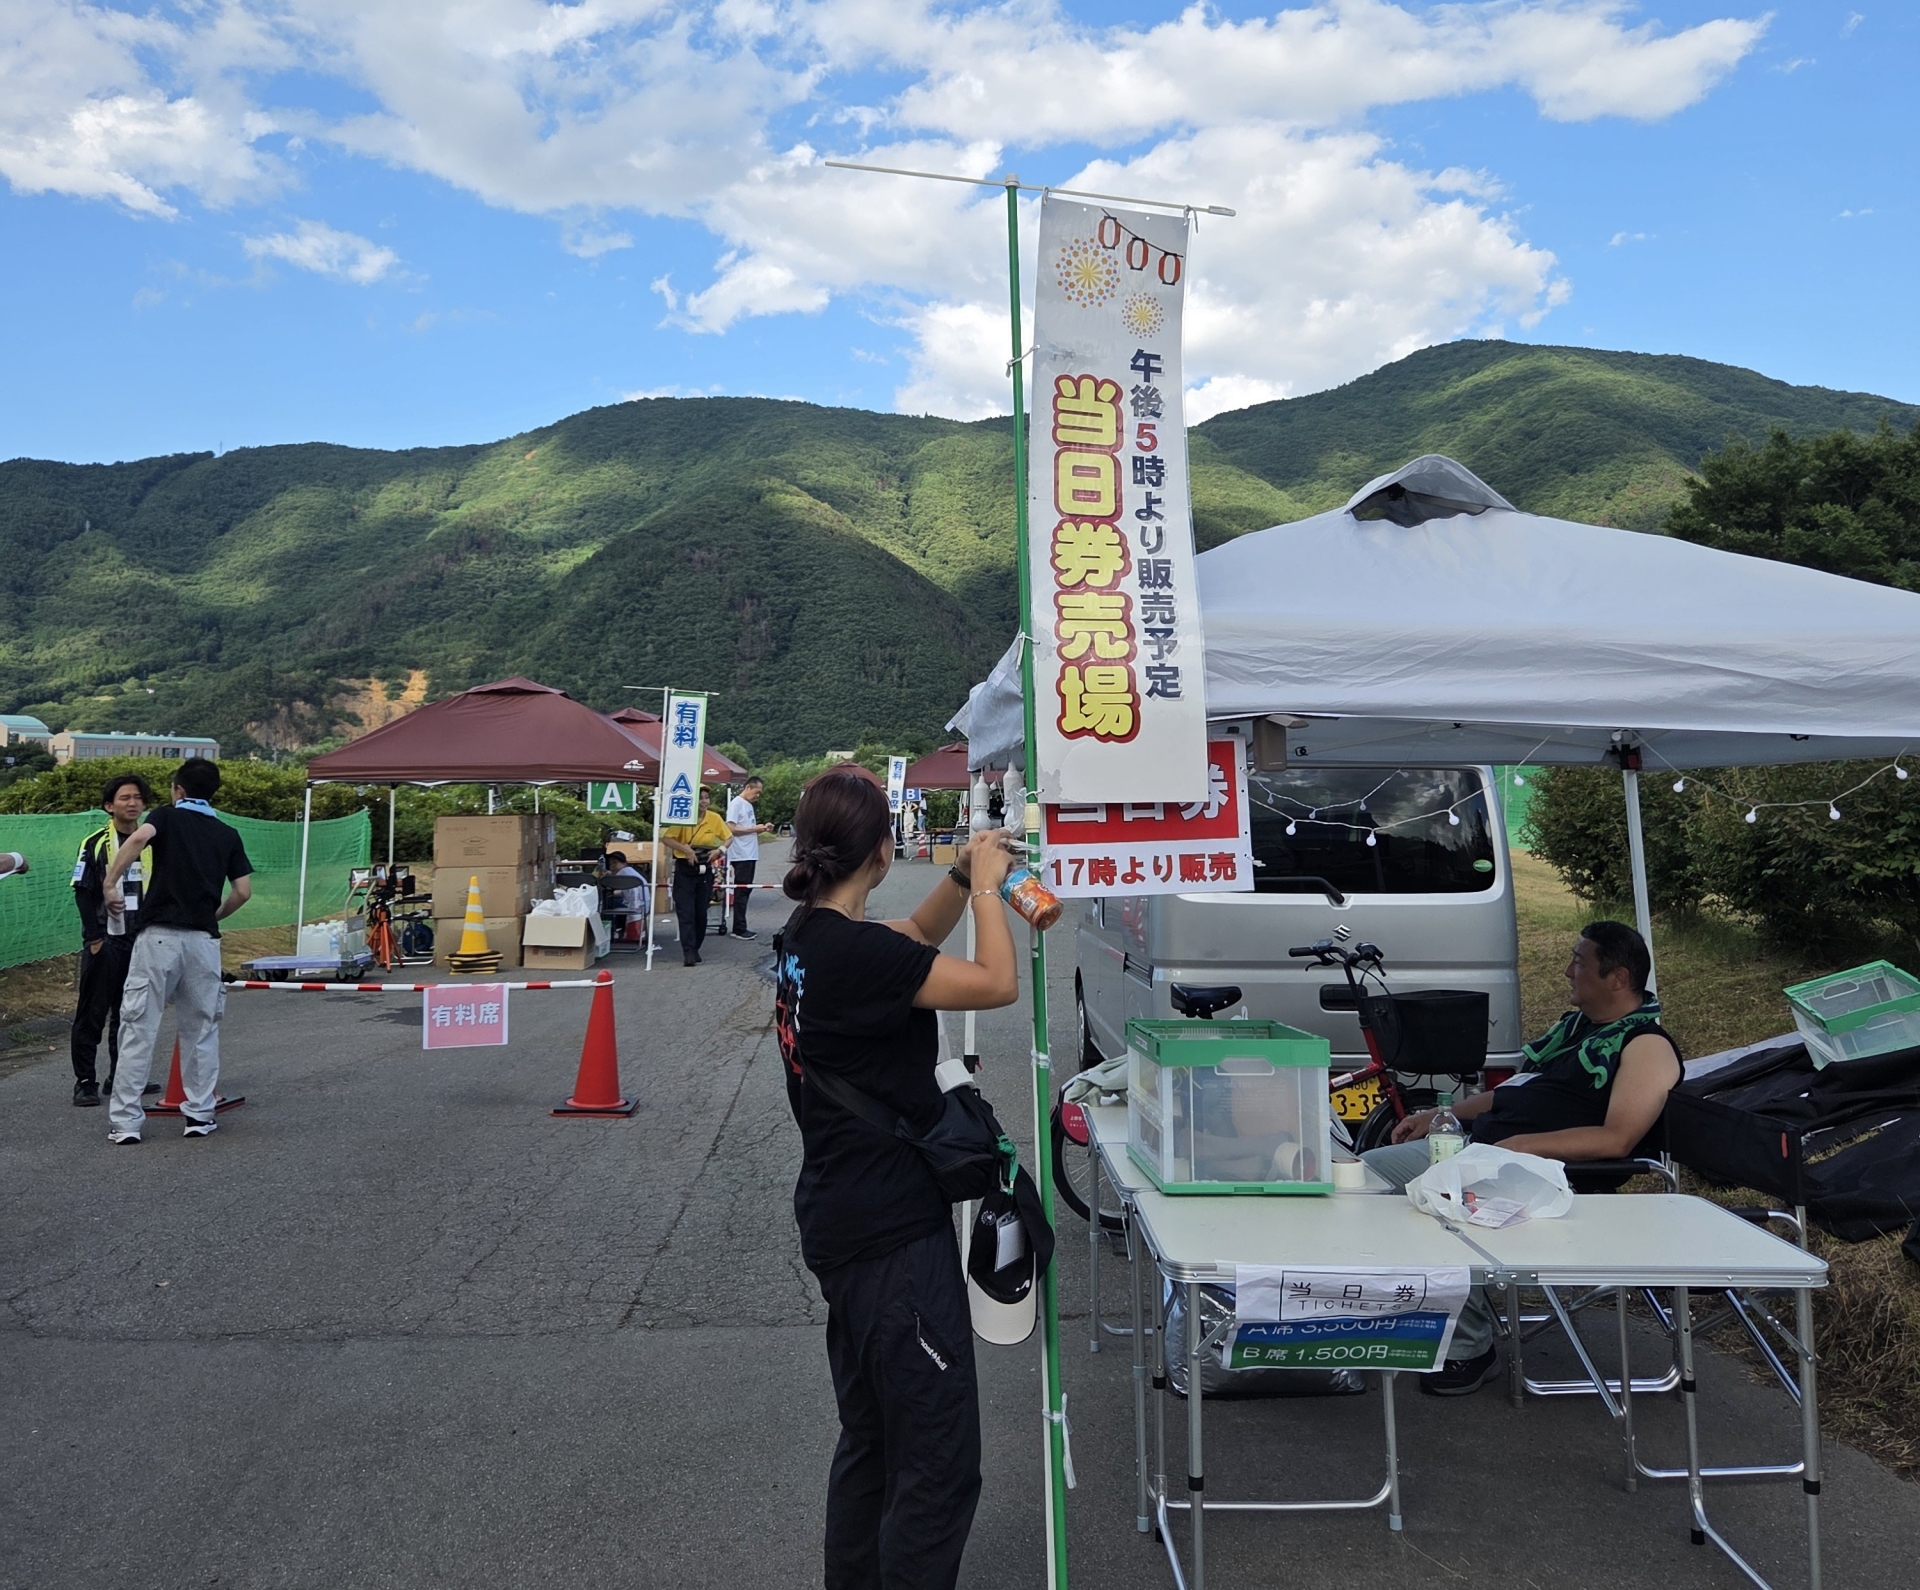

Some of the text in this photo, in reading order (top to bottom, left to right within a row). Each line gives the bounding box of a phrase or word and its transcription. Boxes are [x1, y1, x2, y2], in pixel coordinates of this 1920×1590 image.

[1129, 349, 1182, 700] 午後5時より販売予定
[1053, 374, 1140, 743] 当日券売場
[667, 702, 700, 819] 有料 A席
[600, 782, 623, 807] A
[906, 788, 916, 800] B
[1050, 852, 1237, 887] 17時より販売
[431, 1002, 501, 1028] 有料席
[1289, 1281, 1416, 1301] 当日券
[1296, 1345, 1388, 1361] 1,500円
